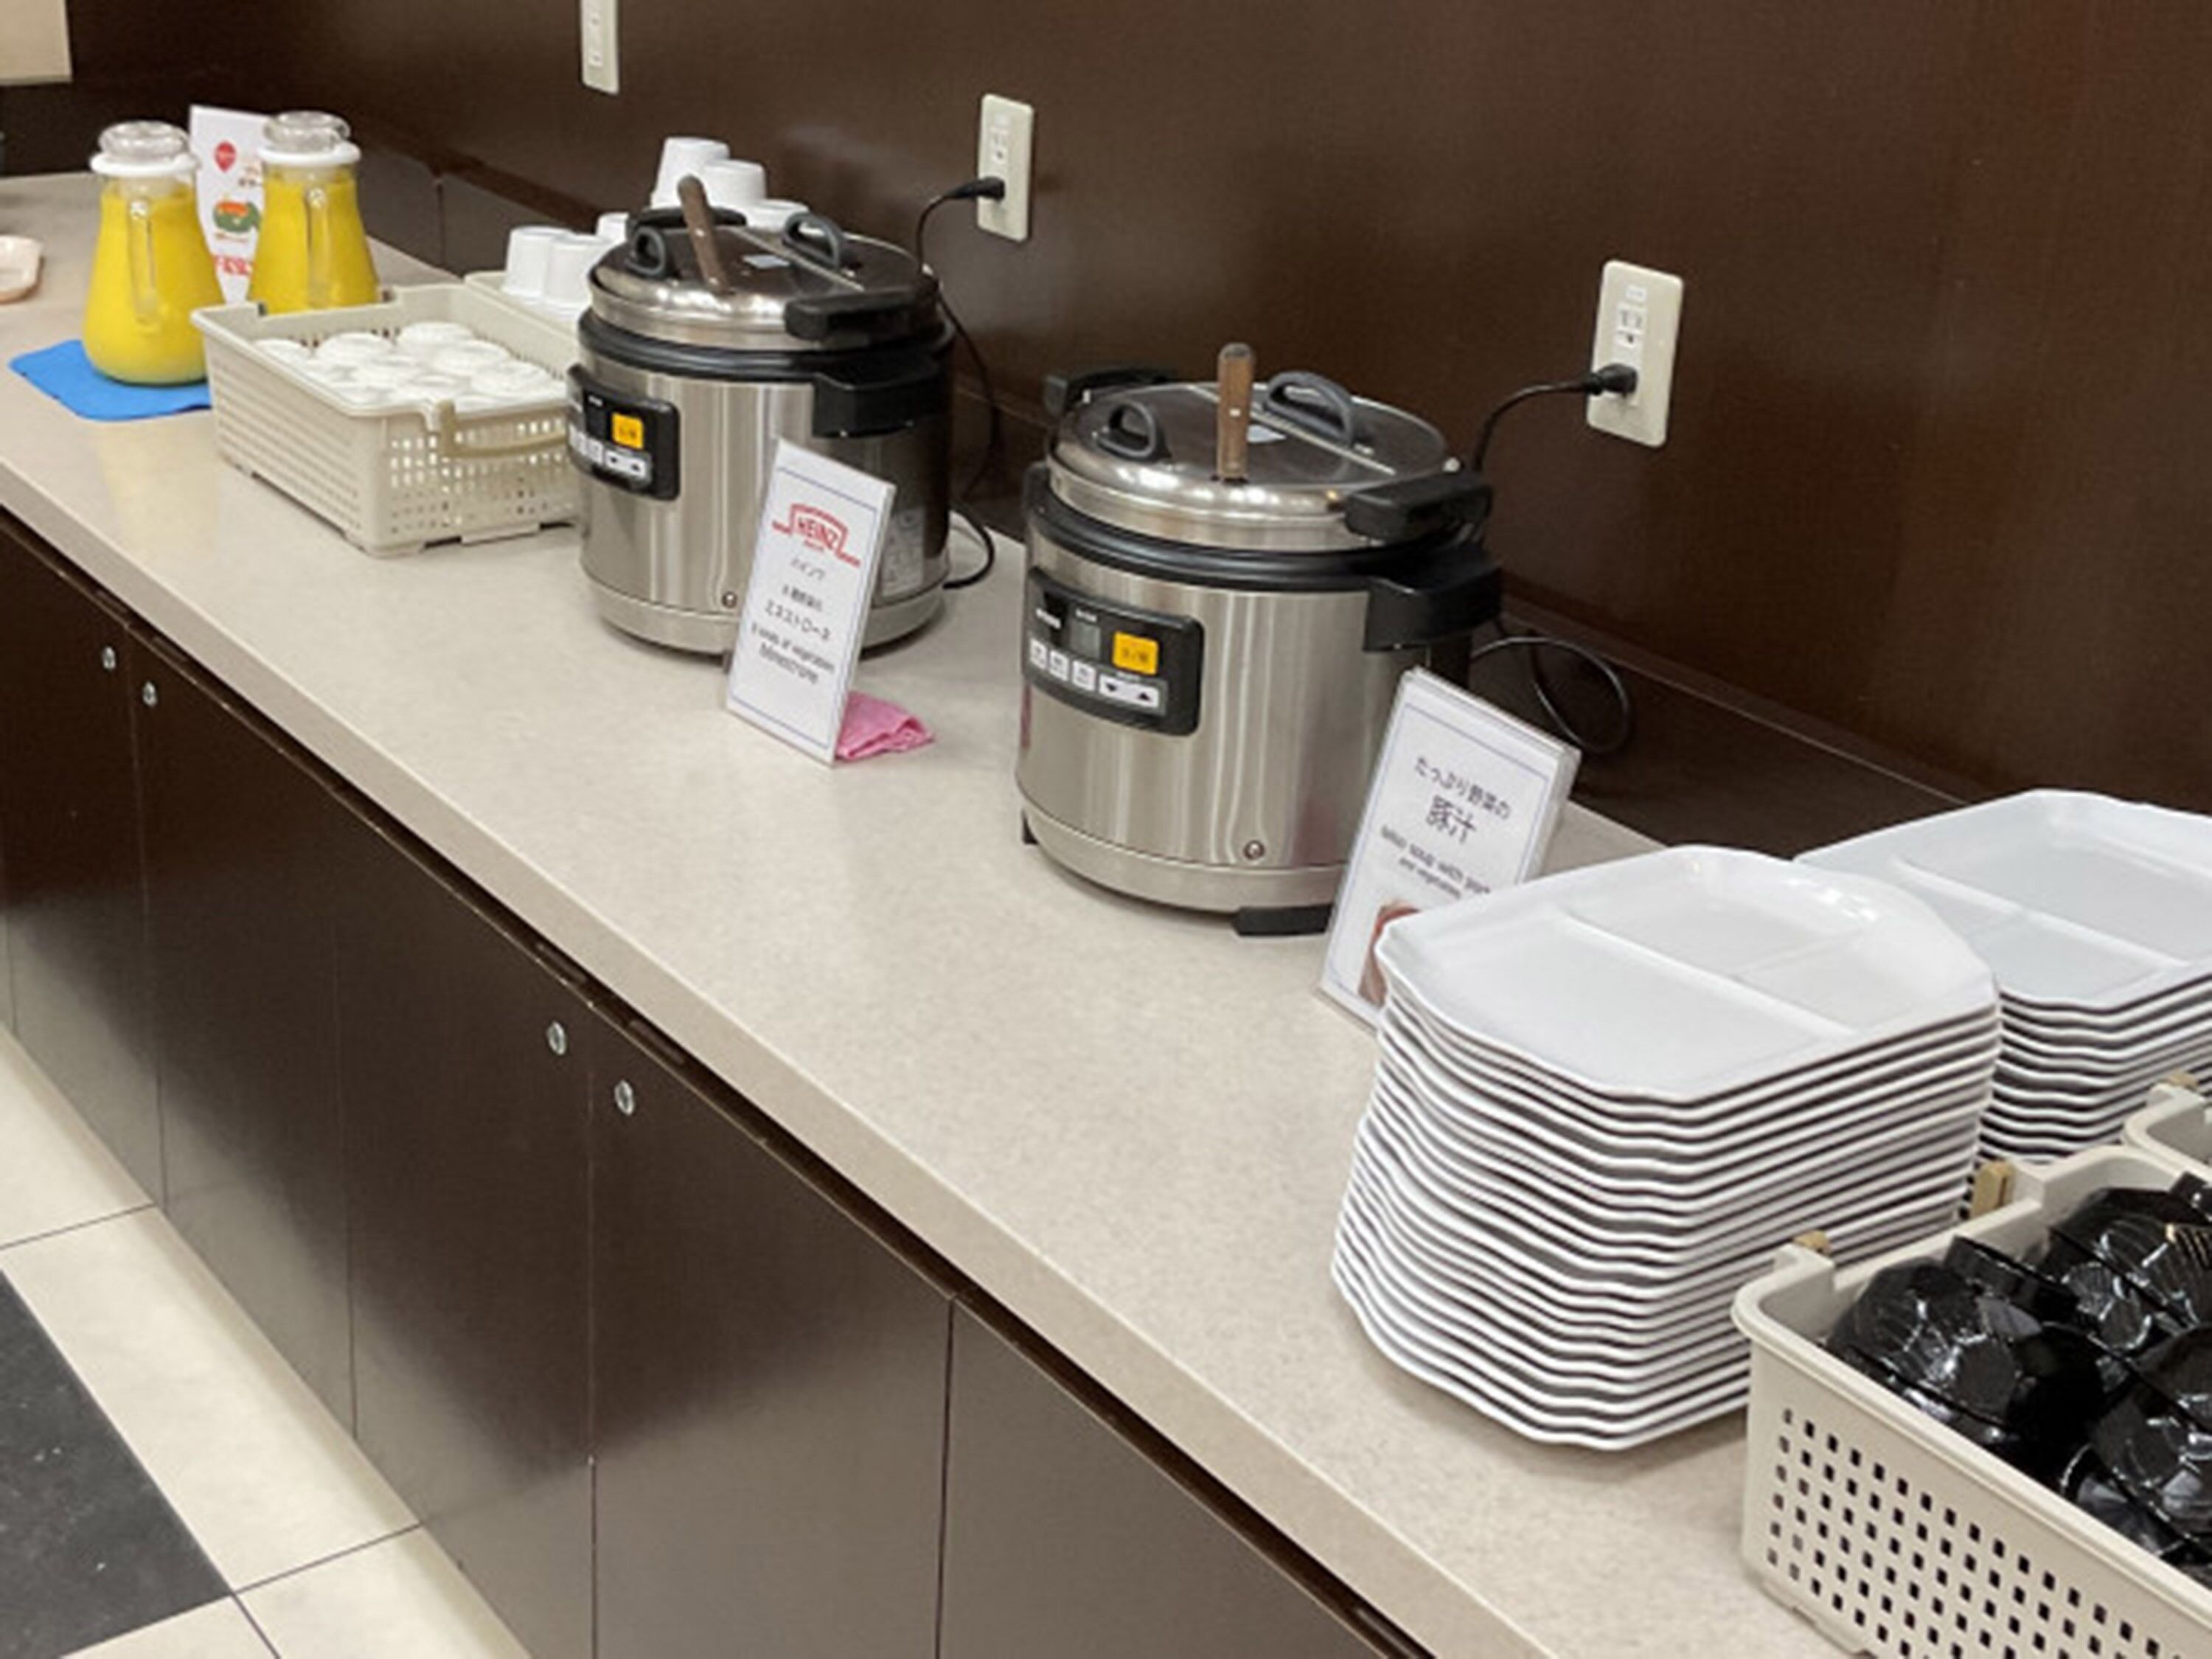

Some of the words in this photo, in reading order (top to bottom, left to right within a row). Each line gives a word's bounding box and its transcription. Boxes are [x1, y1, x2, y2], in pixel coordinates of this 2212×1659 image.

[798, 516, 839, 550] HEINZ
[765, 599, 830, 641] ミネストローネ
[1415, 757, 1510, 819] たっぷり野菜の
[1427, 795, 1476, 844] 豚汁
